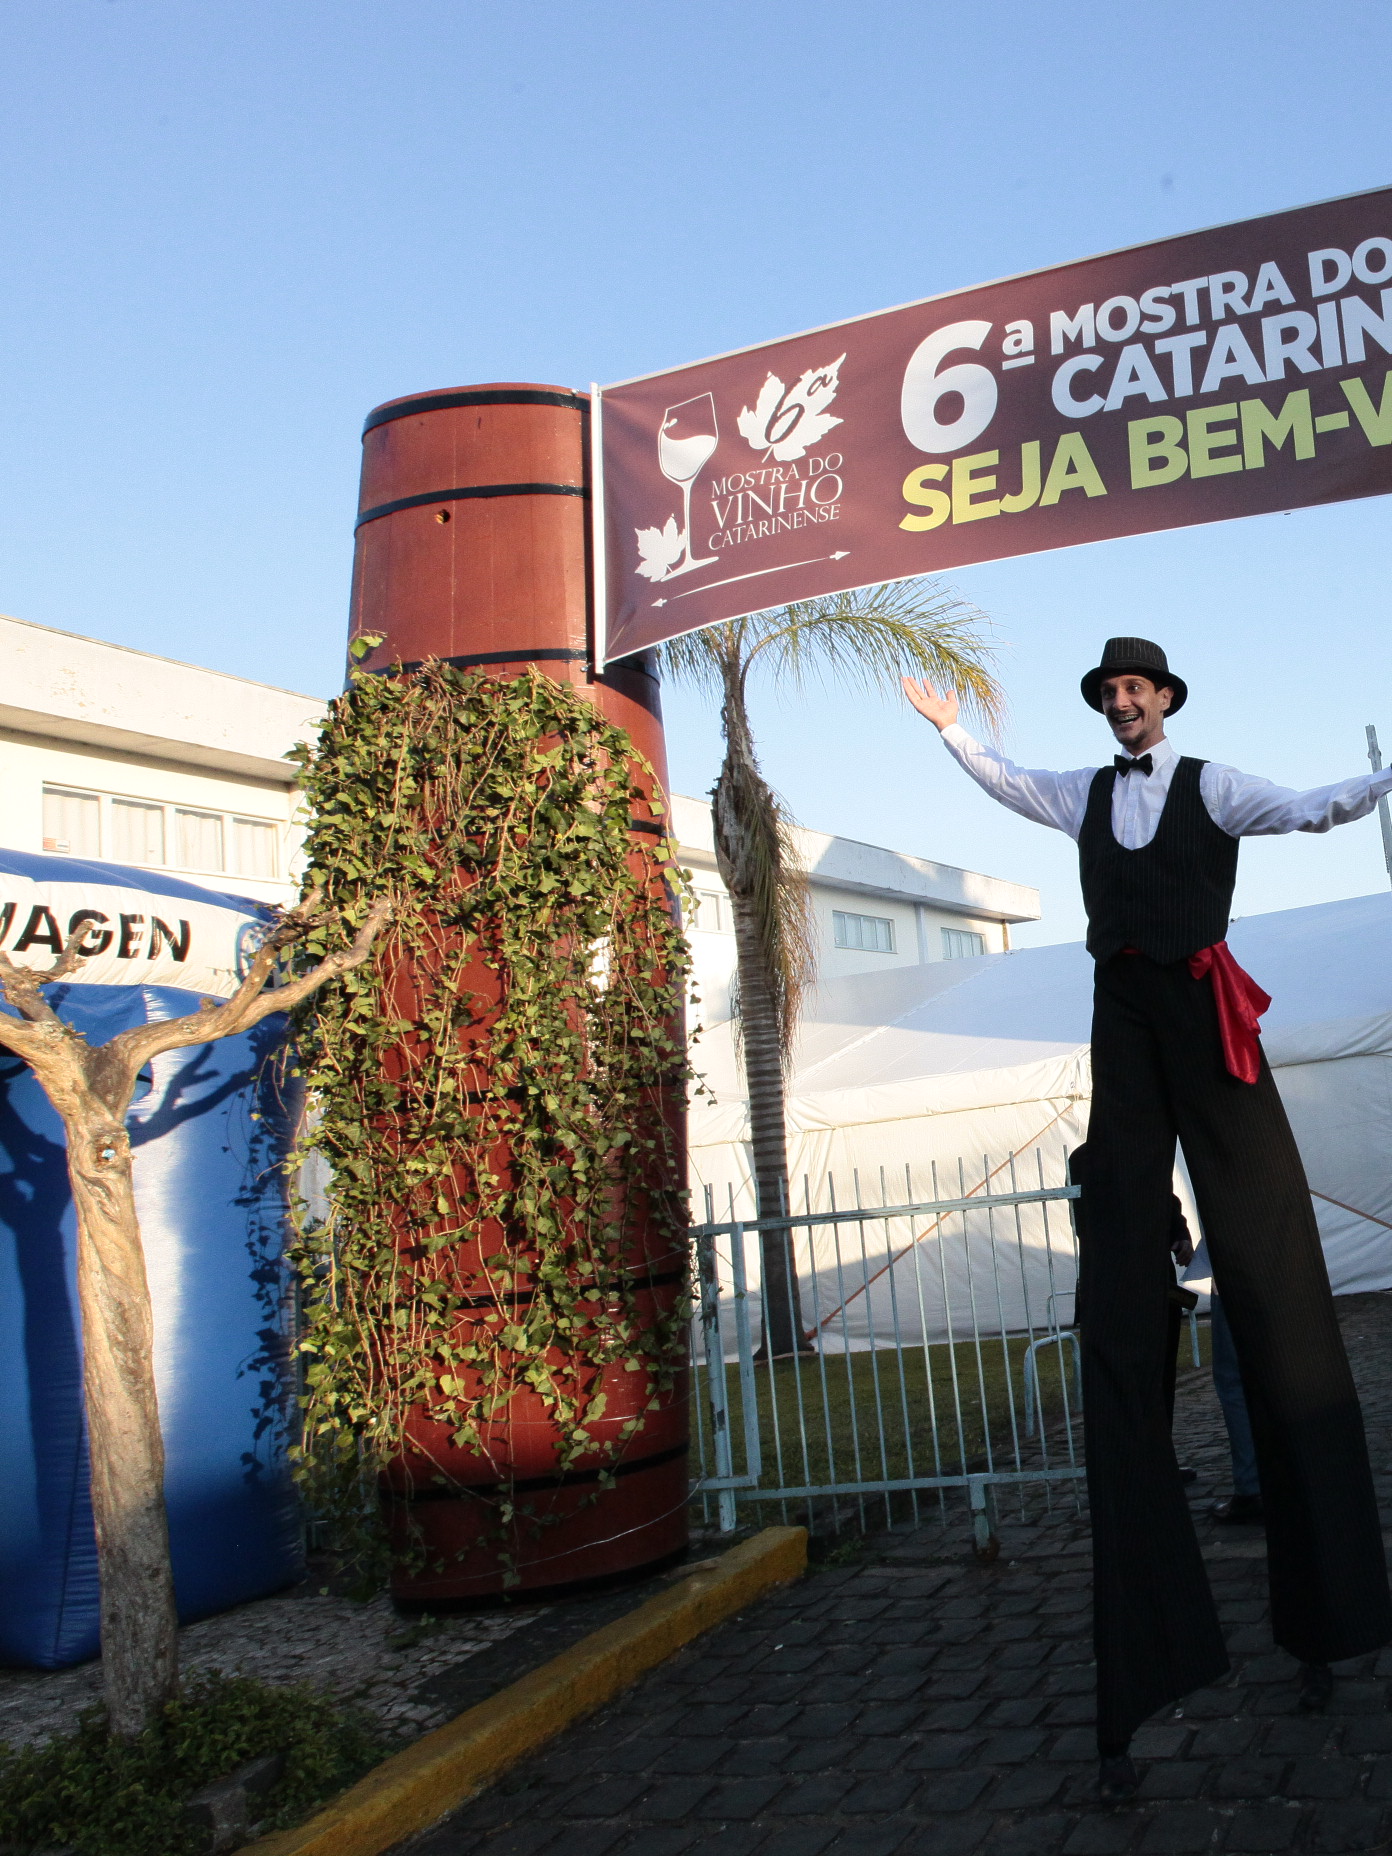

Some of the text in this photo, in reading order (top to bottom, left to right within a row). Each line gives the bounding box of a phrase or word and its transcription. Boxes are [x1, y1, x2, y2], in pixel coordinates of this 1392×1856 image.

[1050, 262, 1295, 355] MOSTRA
[711, 452, 843, 498] MOSTRA DO
[711, 473, 843, 529] VINHO
[898, 431, 1108, 532] SEJA
[708, 503, 841, 550] CATARINENSE
